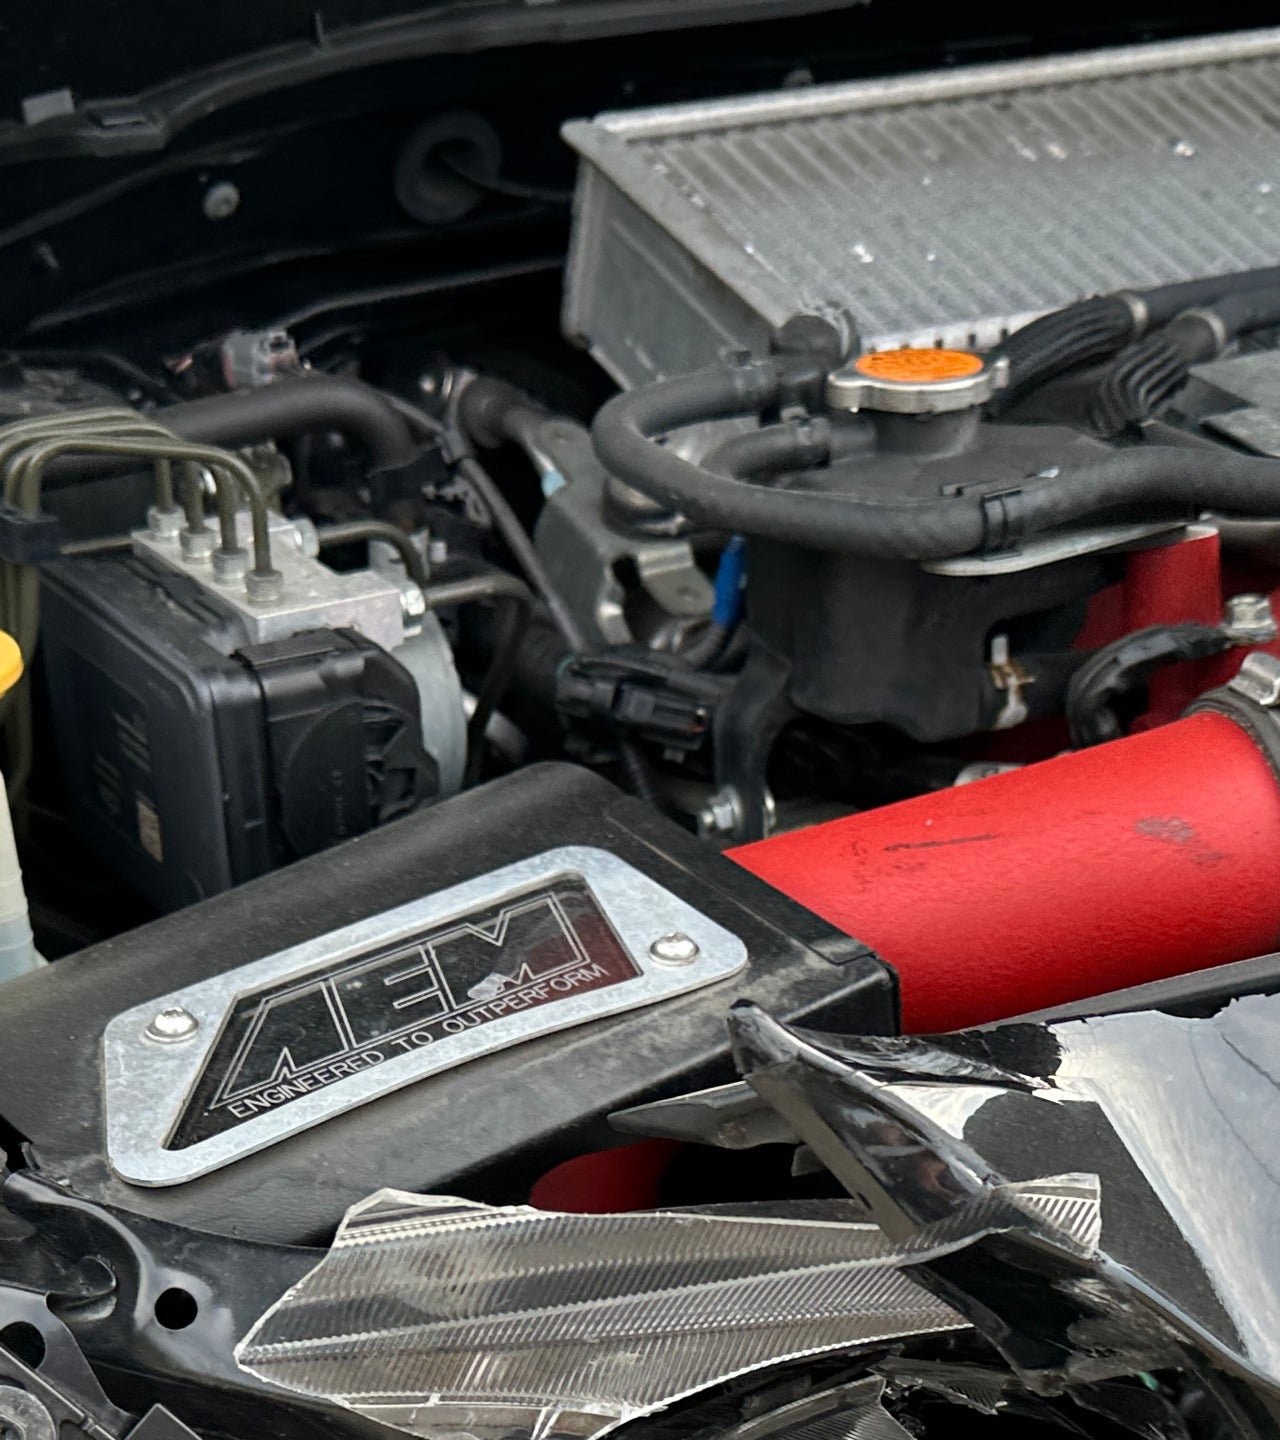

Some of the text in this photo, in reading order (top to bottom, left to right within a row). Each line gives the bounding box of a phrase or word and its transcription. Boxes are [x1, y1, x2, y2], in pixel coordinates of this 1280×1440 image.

[208, 891, 591, 1111] AEM
[226, 962, 610, 1119] ENGINEERED TO OUTPERFORM
